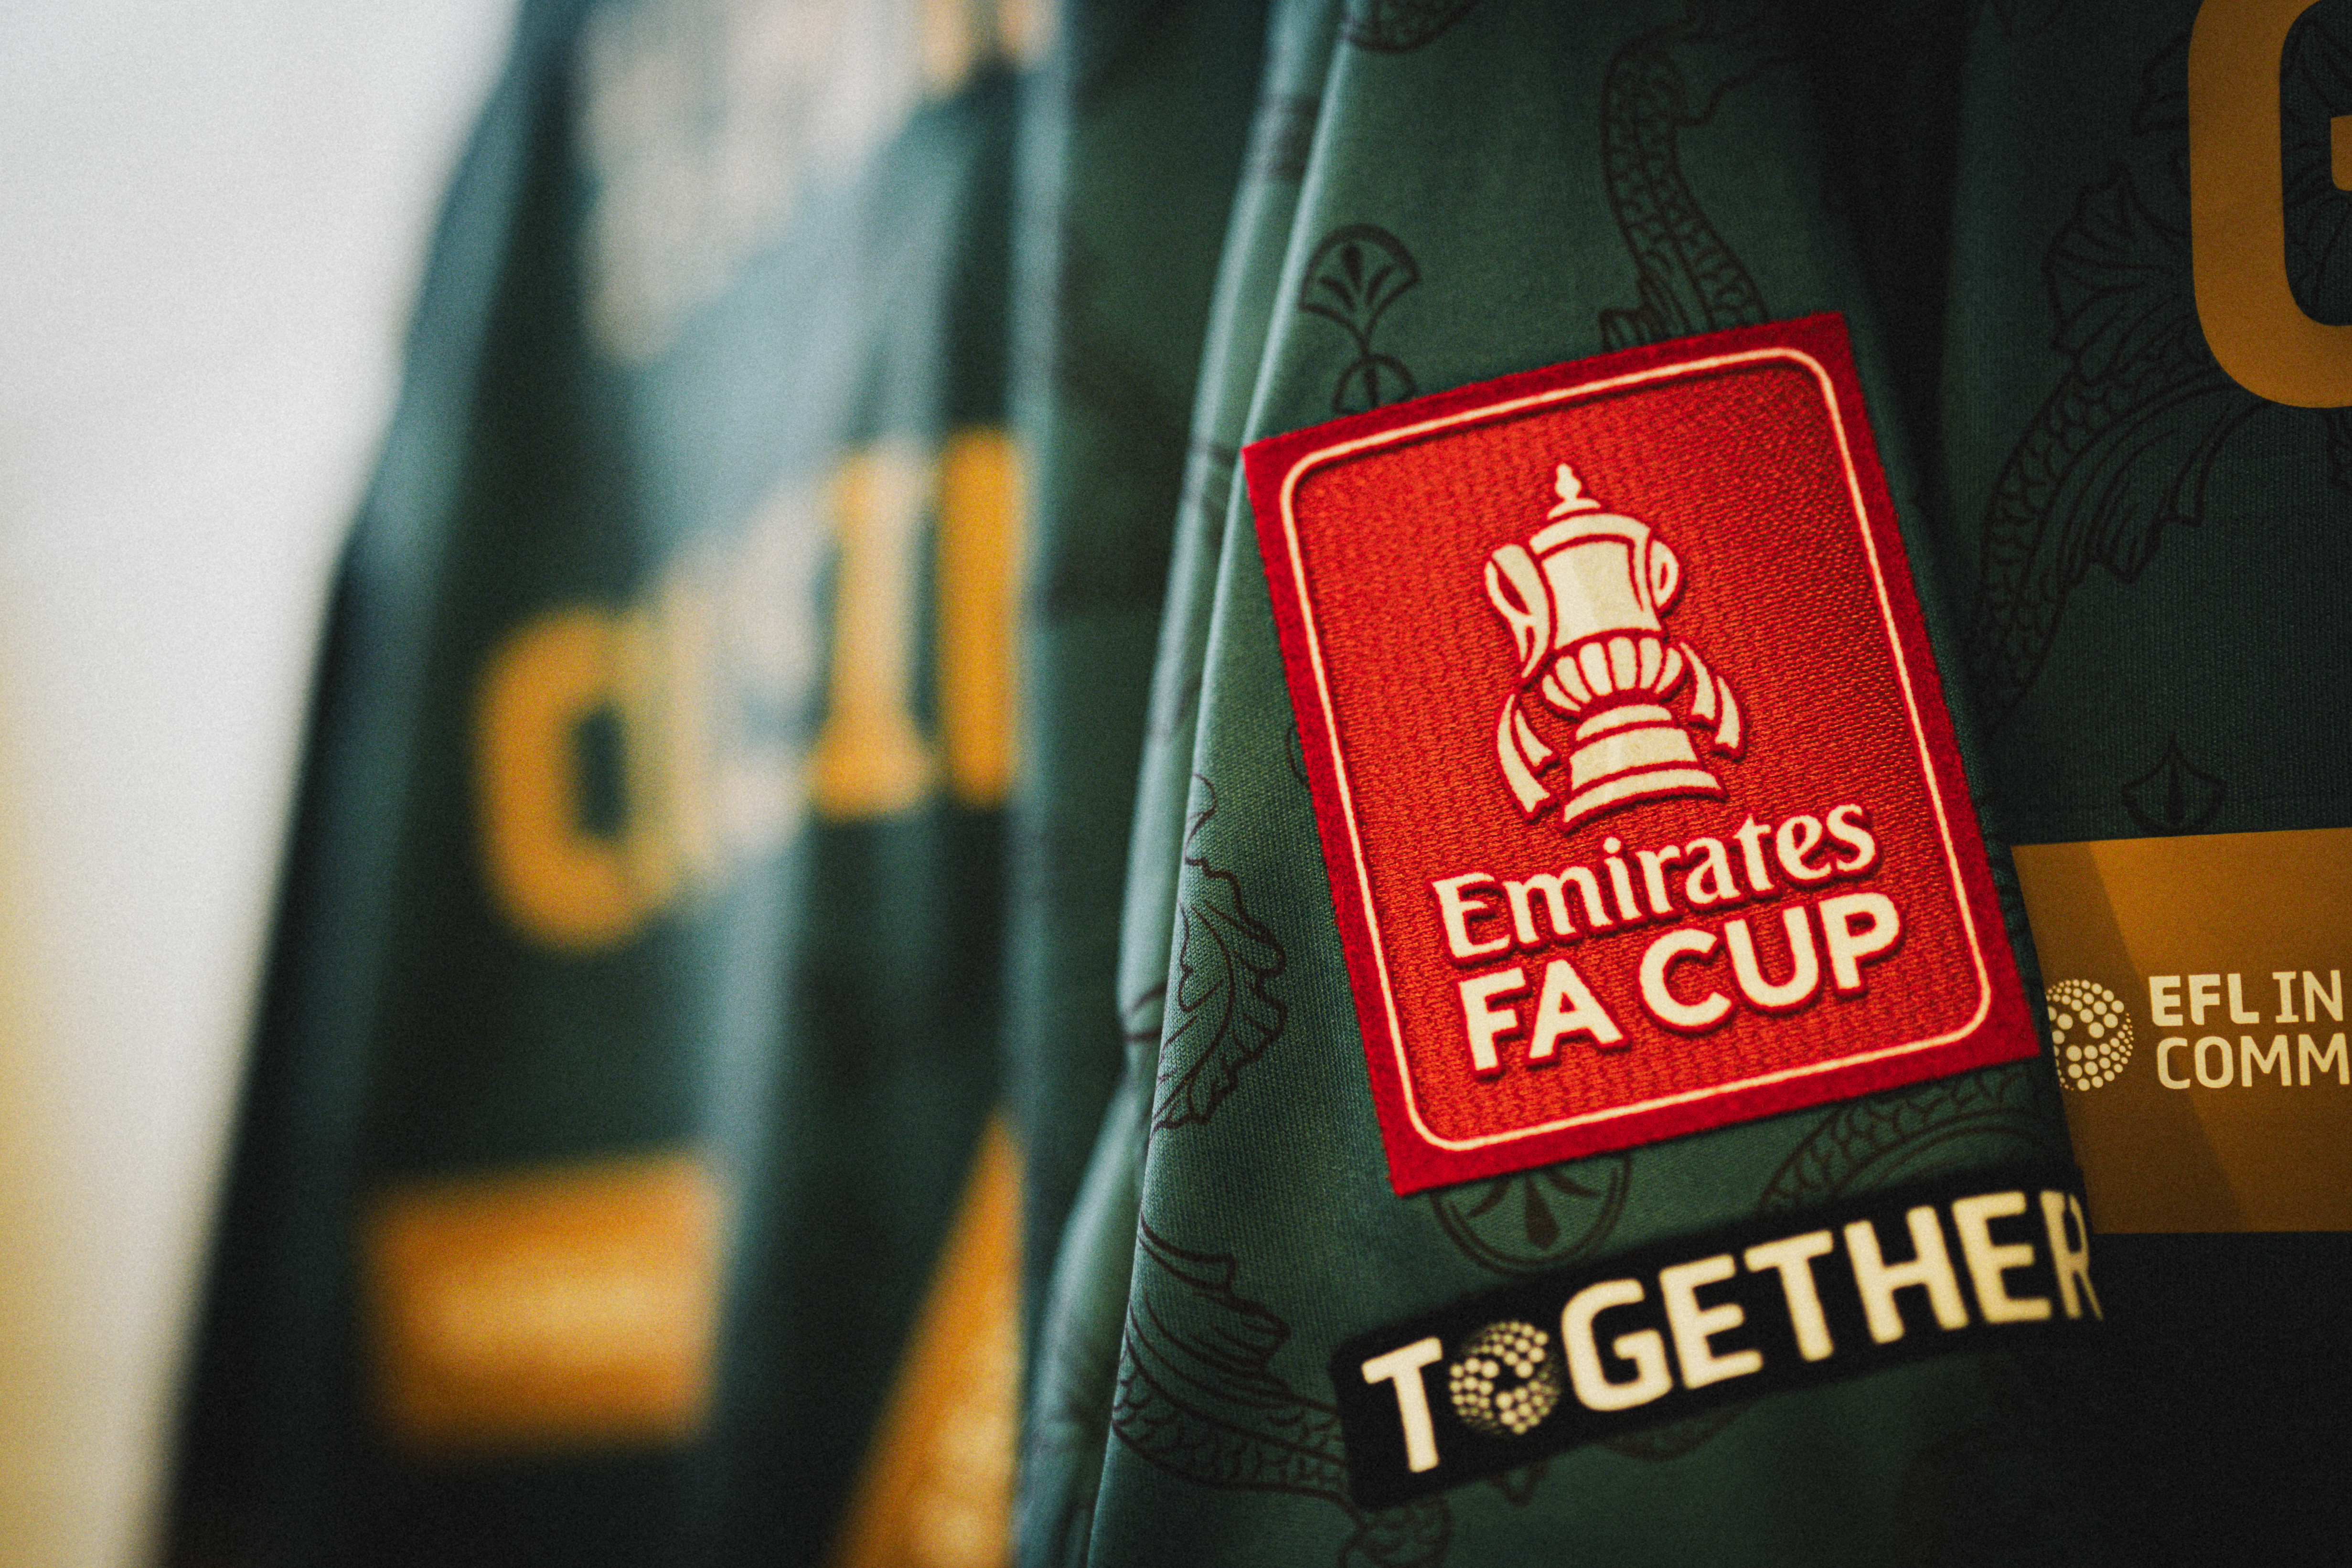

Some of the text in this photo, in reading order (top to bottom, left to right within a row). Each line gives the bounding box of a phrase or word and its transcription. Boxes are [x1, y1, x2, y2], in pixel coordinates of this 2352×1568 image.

[1433, 803, 1876, 958] Emirates
[1458, 892, 1901, 1071] FA CUP
[2149, 970, 2343, 1026] EFL IN
[2157, 1033, 2350, 1089] COMM
